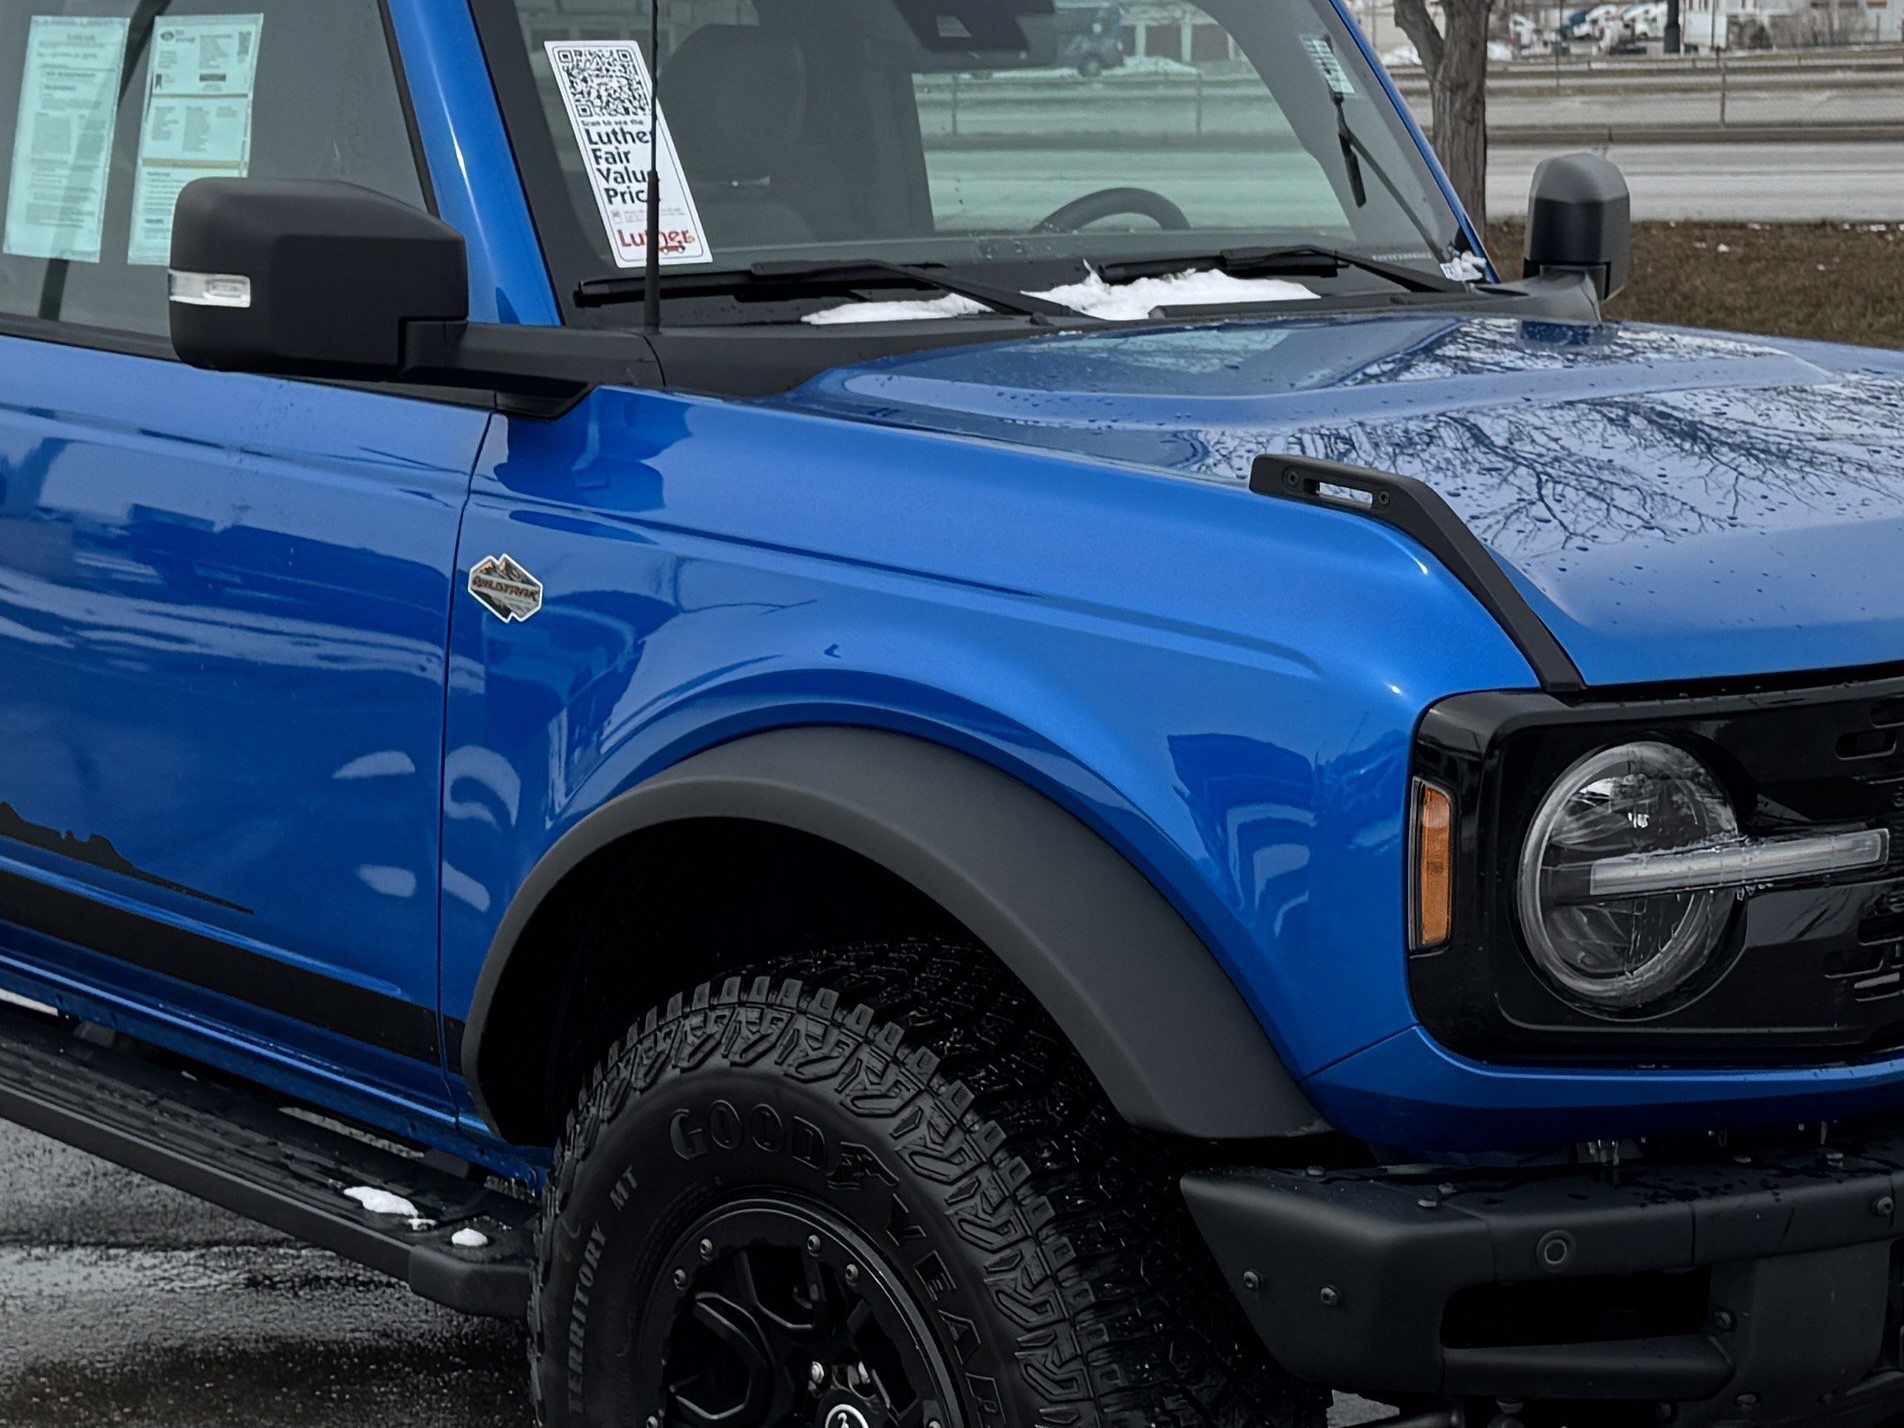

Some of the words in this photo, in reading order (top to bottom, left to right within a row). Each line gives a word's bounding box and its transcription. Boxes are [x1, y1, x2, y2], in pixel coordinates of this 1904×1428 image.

[591, 146, 631, 165] Fair
[596, 166, 659, 184] Valu
[604, 186, 660, 205] Pric
[567, 1220, 608, 1416] TERRITORY
[608, 1164, 640, 1213] MT
